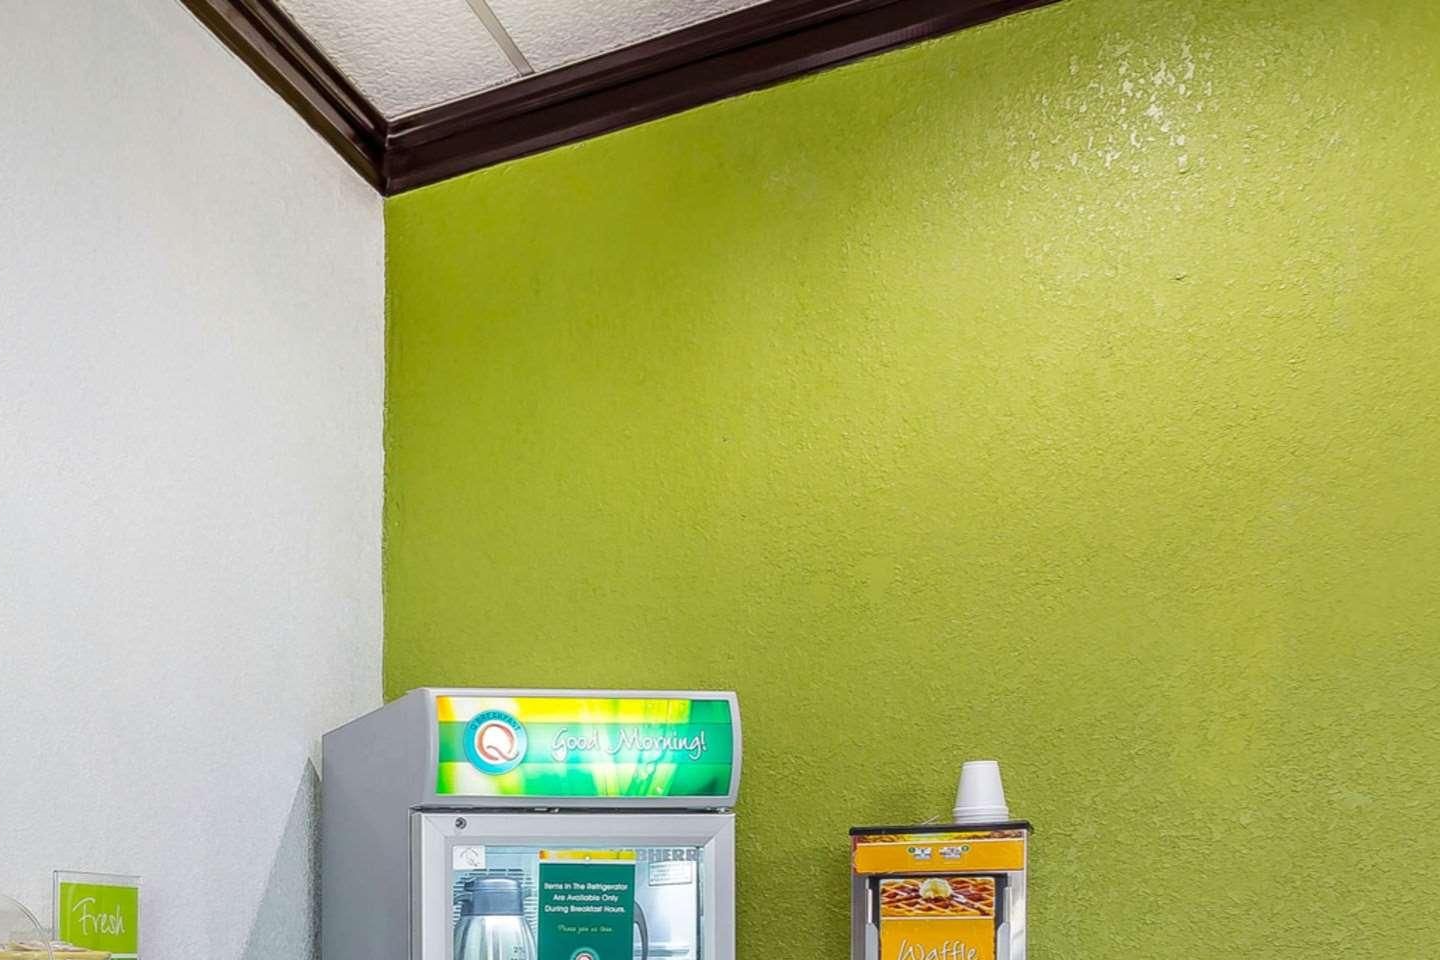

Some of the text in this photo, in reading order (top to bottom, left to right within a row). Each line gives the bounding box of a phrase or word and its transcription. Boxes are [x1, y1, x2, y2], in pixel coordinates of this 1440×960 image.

[552, 727, 707, 762] Good Morning!
[544, 905, 569, 914] During
[601, 894, 619, 903] Only
[72, 897, 126, 936] Fresh
